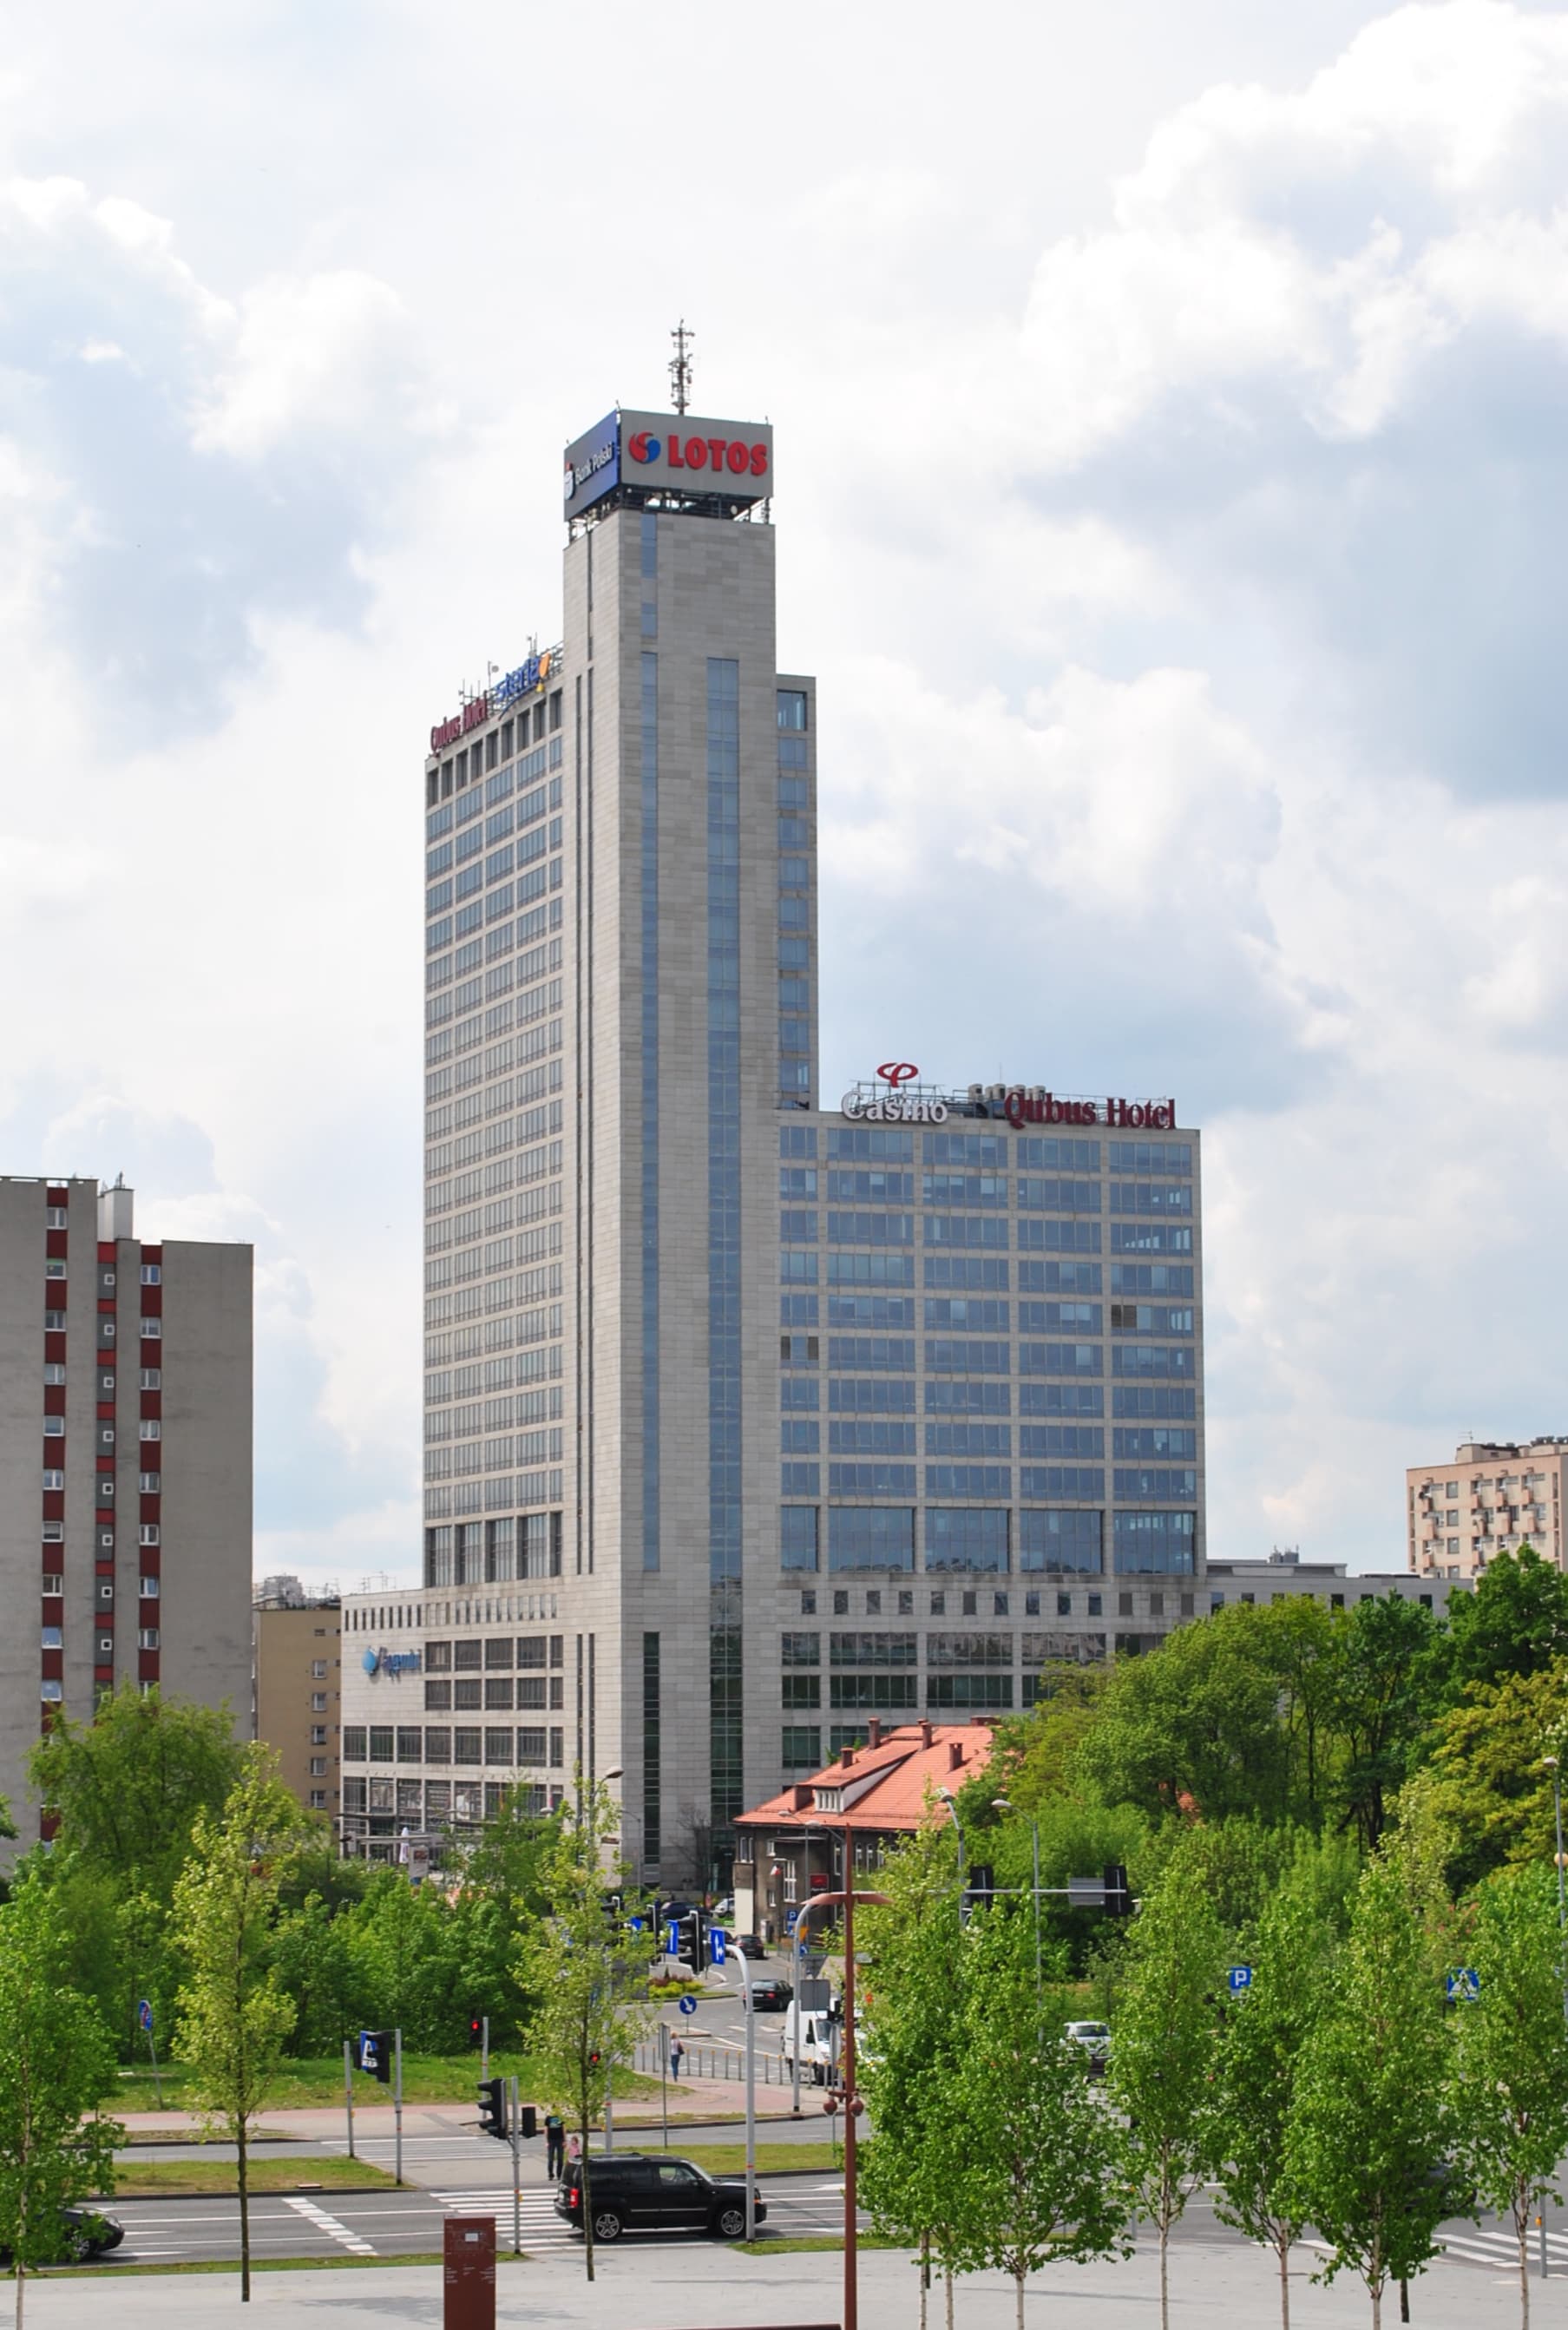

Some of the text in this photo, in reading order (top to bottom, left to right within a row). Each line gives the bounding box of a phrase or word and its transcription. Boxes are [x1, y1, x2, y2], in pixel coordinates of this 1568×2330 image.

[668, 434, 768, 476] LOTOS
[841, 1089, 948, 1125] Casino
[1004, 1092, 1176, 1130] Qubus Hotel
[790, 1912, 797, 1920] P
[1235, 1970, 1247, 1986] P
